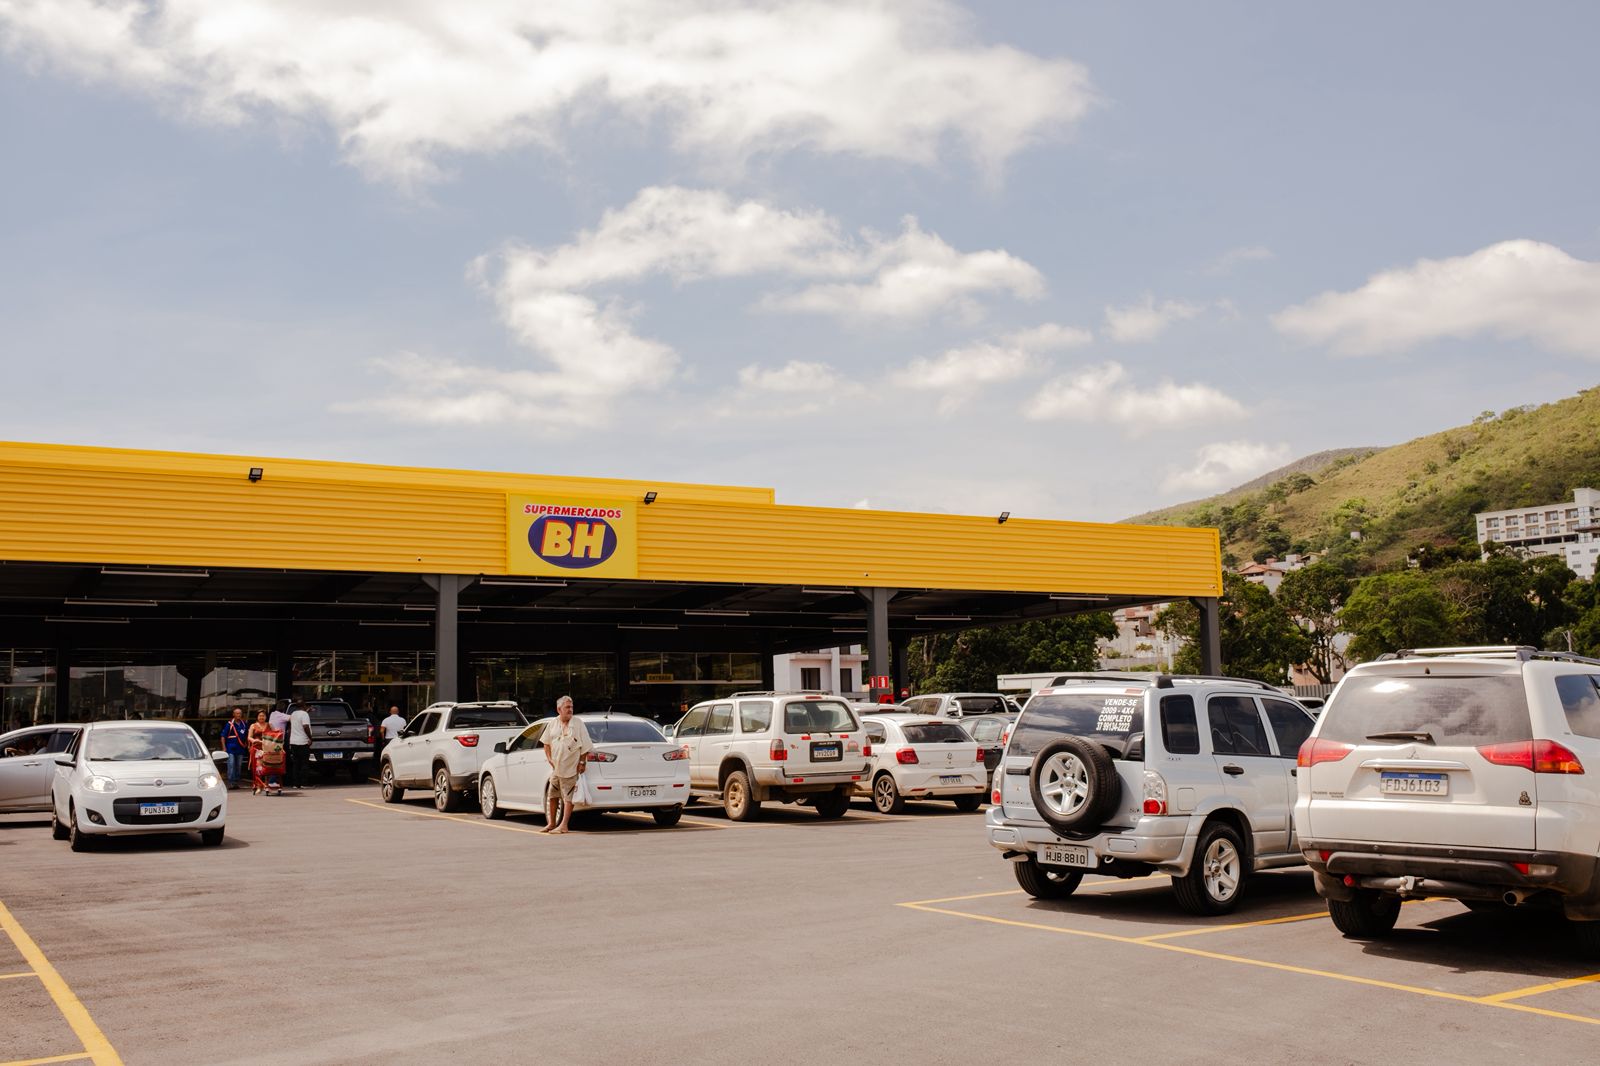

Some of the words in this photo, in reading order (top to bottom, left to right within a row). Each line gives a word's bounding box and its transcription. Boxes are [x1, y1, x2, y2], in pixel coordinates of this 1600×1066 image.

[524, 504, 622, 519] SUPERMERCADOS
[540, 519, 606, 559] BH
[1104, 698, 1138, 706] VENDE-SE
[1100, 706, 1118, 714] 2009
[1121, 706, 1135, 714] 4X4
[1098, 714, 1132, 722] COMPLETO
[1095, 722, 1104, 731] 37
[144, 806, 175, 814] PUN3A36
